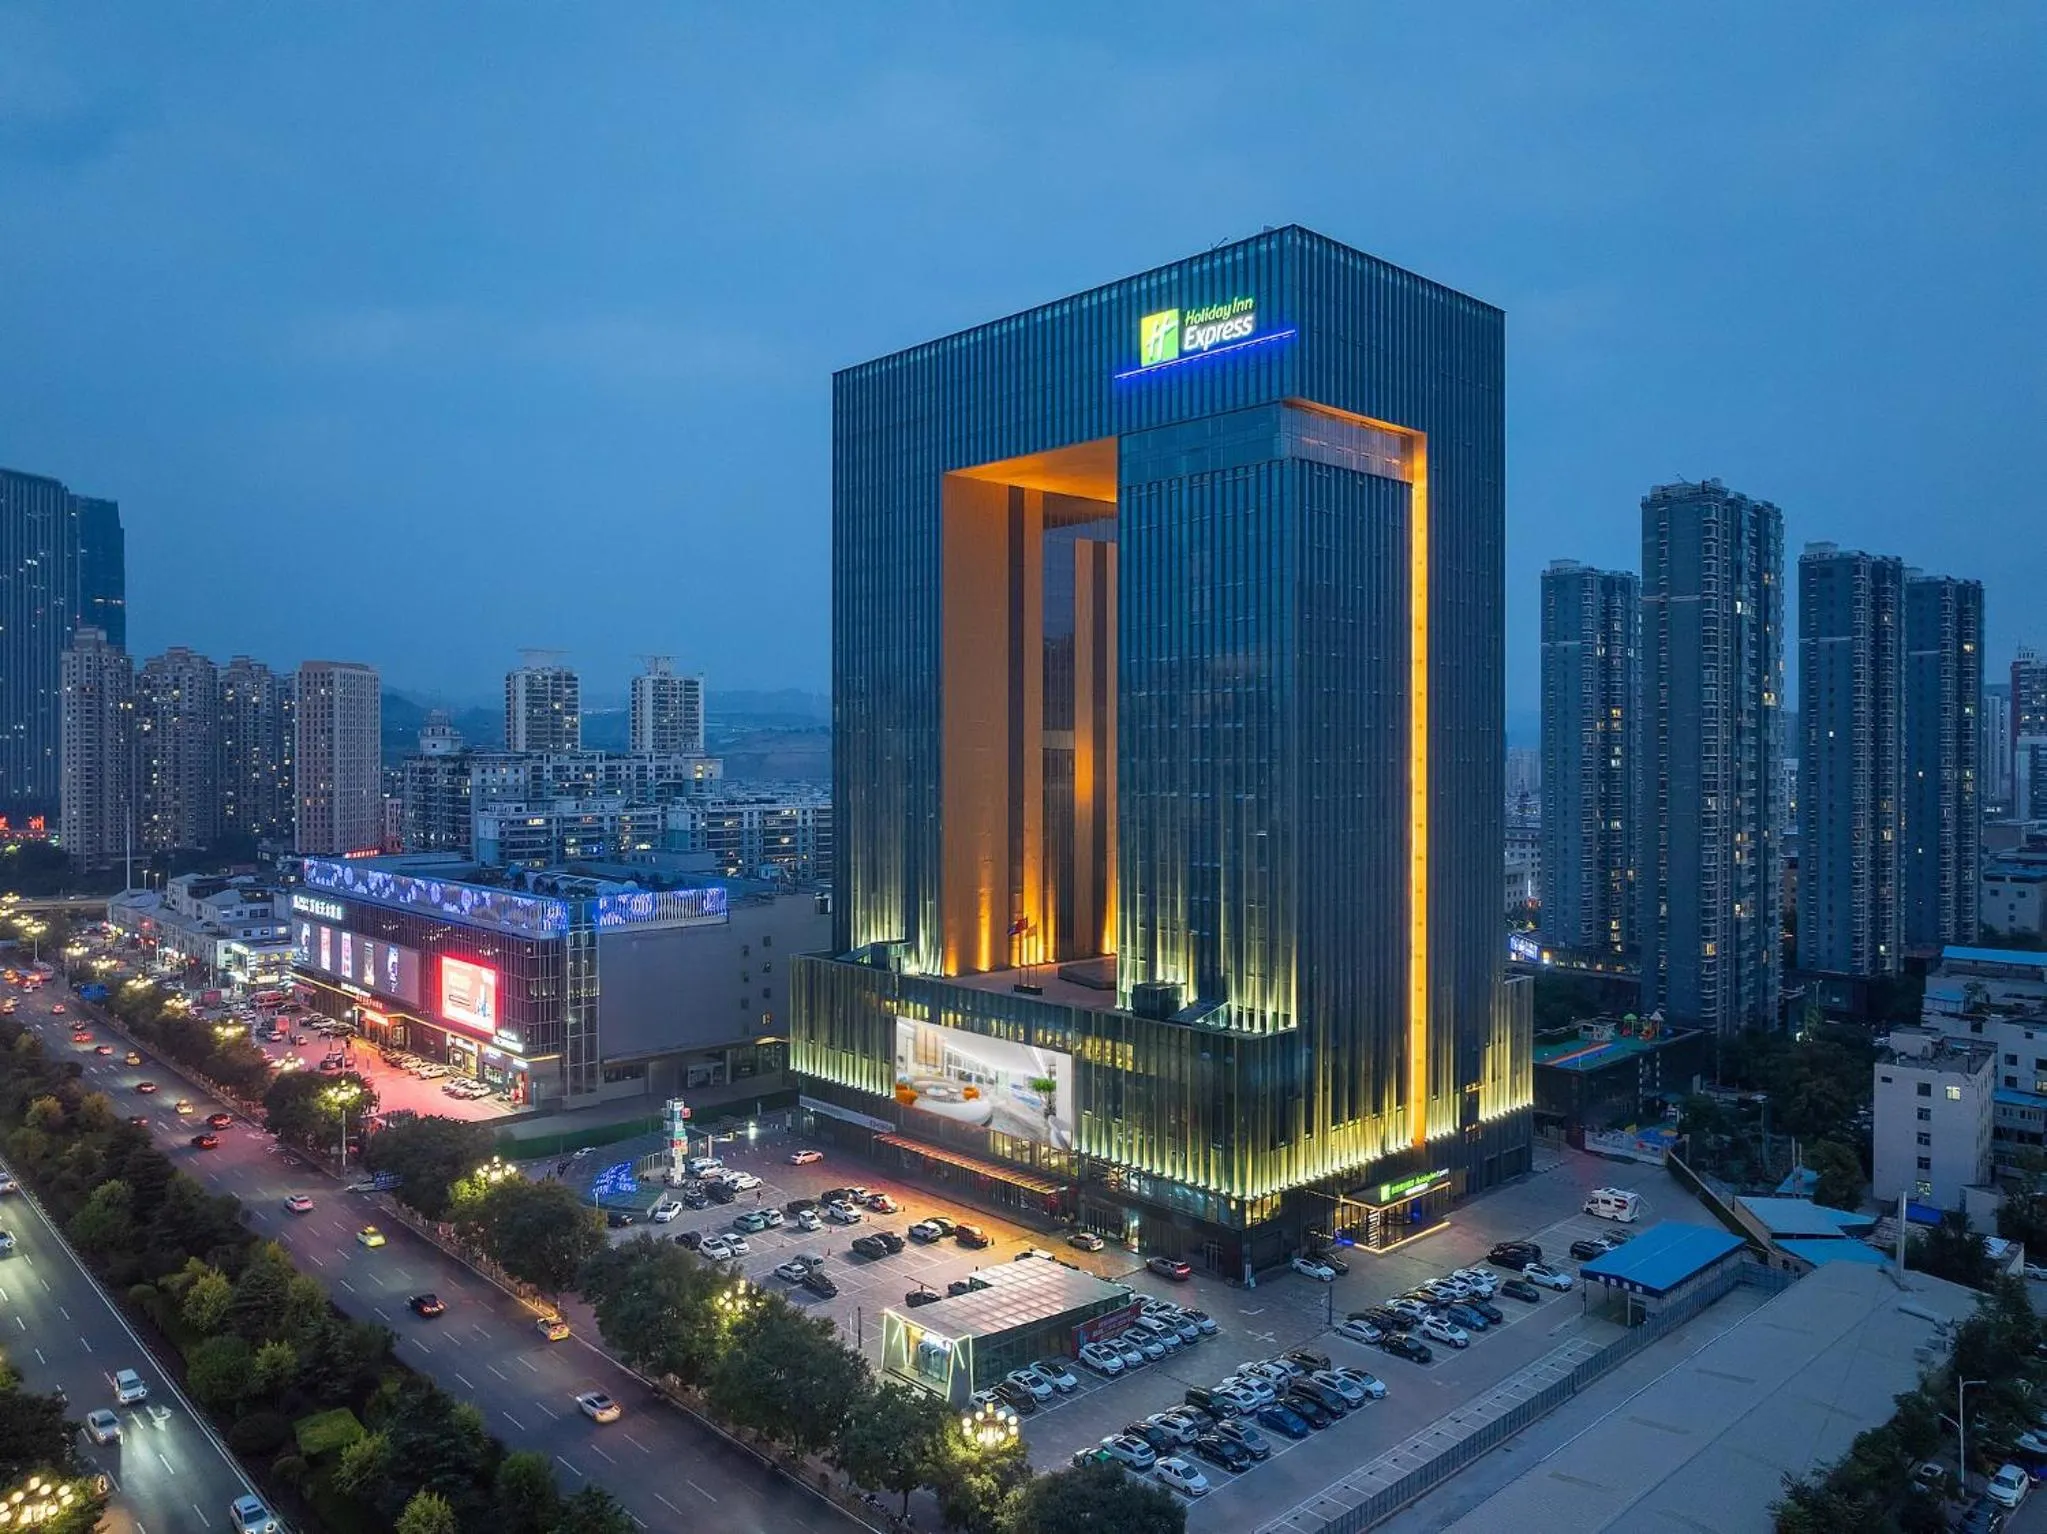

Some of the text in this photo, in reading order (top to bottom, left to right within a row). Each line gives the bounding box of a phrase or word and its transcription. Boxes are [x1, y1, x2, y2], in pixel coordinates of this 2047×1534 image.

[1184, 296, 1254, 327] Holiday Inn
[1183, 316, 1254, 351] Express
